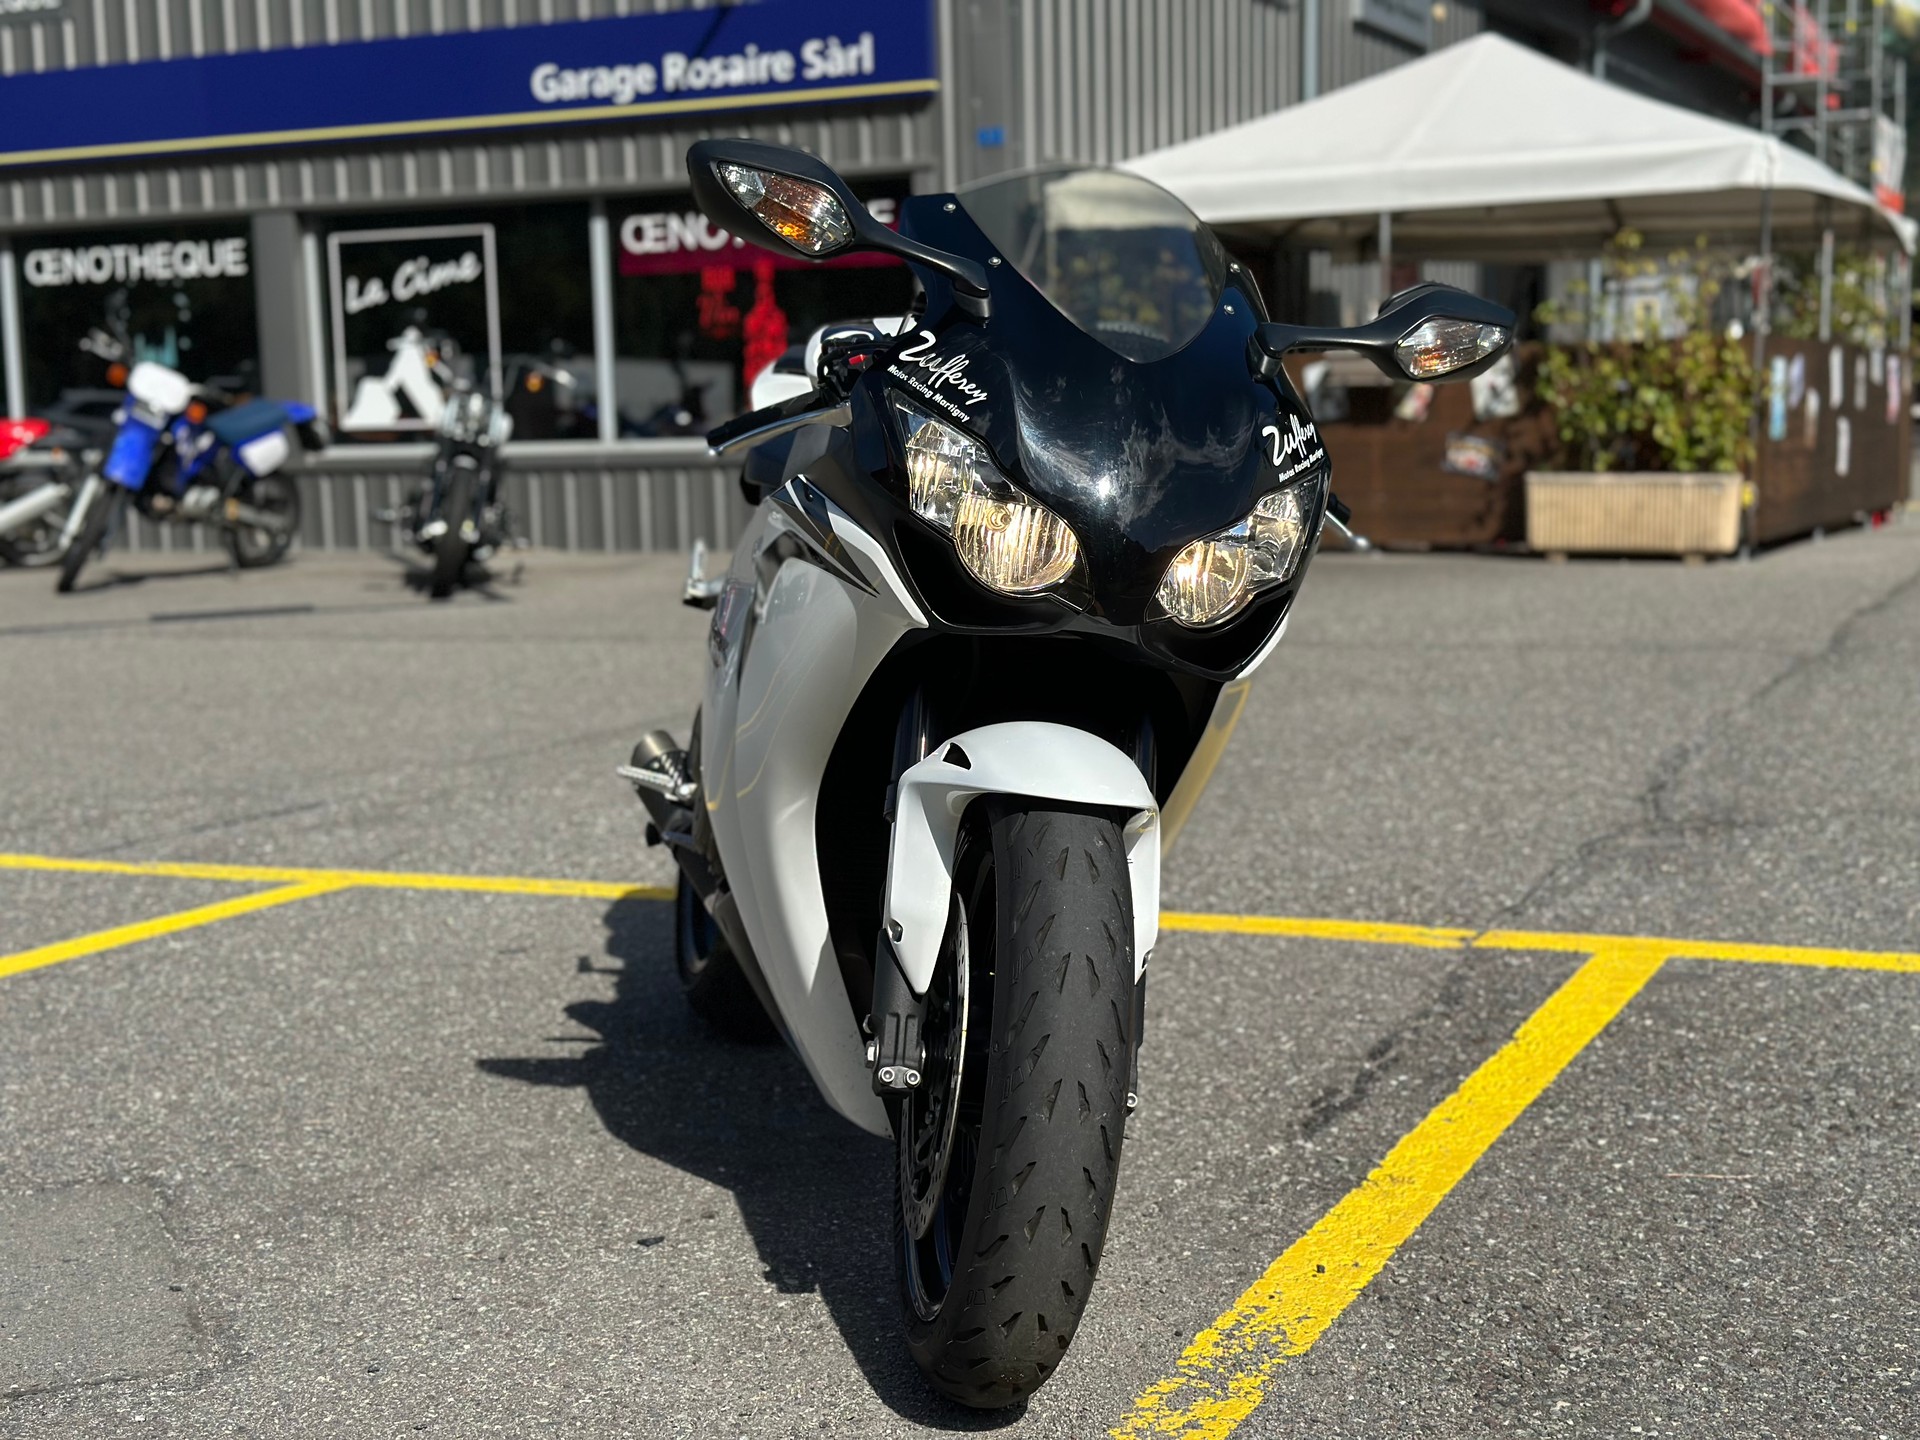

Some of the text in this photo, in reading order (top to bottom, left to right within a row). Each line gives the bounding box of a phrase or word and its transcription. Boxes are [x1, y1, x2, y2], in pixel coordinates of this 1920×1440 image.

[530, 31, 874, 105] Garage Rosaire Sàrl
[23, 237, 249, 287] ŒNOTHEQUE
[345, 250, 483, 315] La Cime
[887, 364, 970, 422] Motos Racing Martigny
[899, 330, 988, 405] Zufferey
